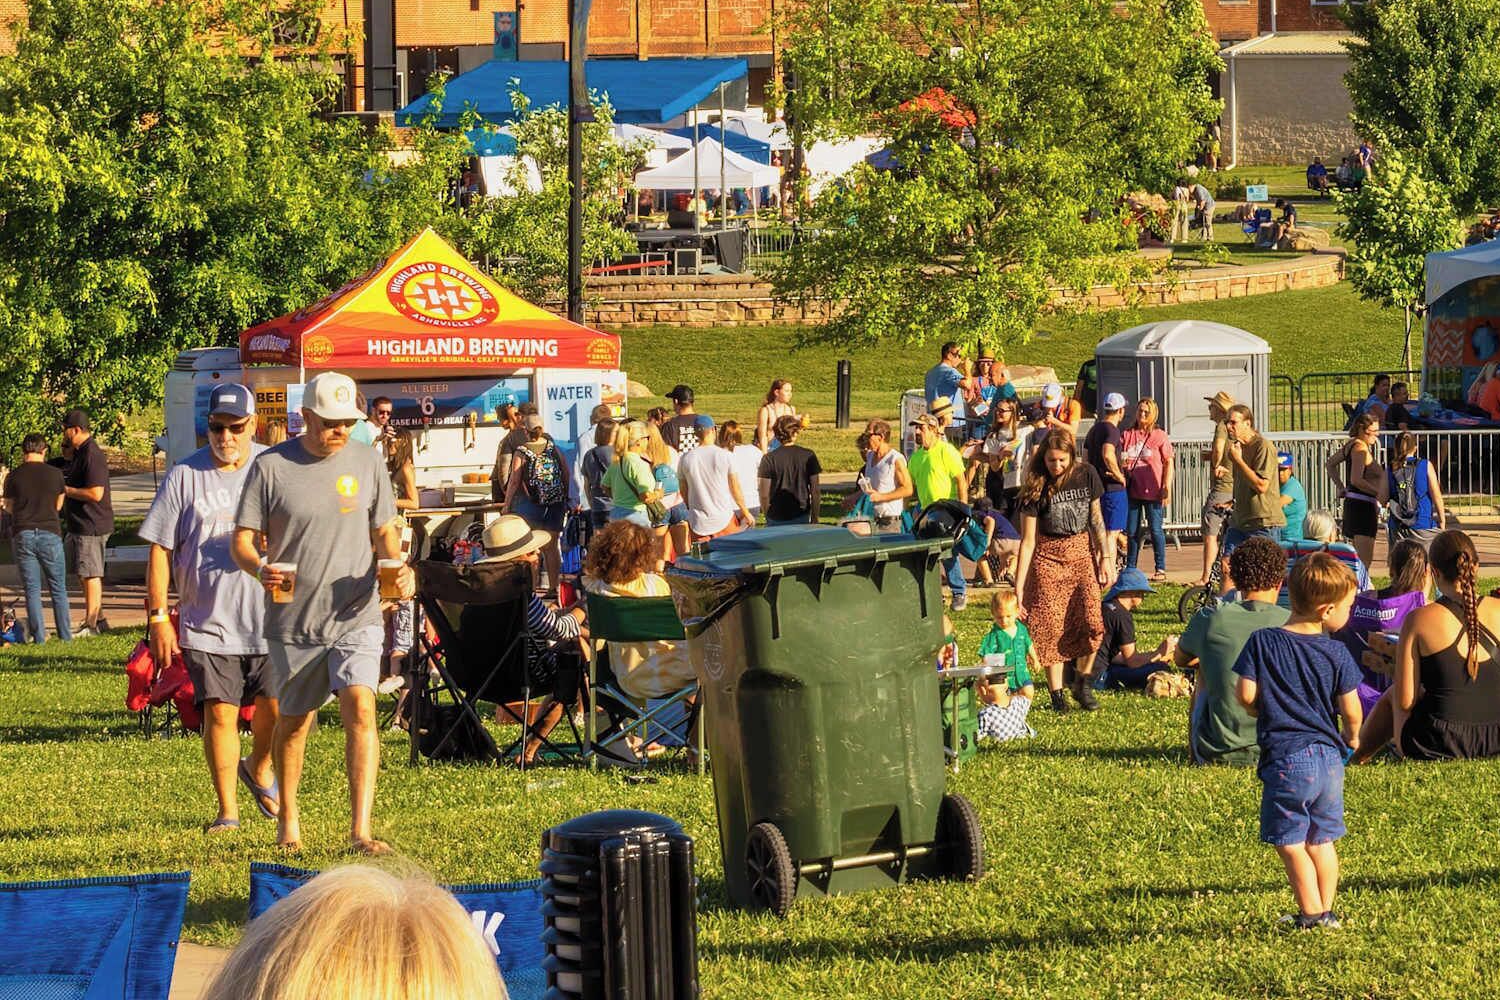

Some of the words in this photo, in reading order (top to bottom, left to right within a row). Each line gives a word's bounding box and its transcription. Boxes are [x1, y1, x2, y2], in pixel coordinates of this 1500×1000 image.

[390, 263, 437, 294] HIGHLAND
[441, 265, 494, 300] BREWING
[368, 338, 465, 356] HIGHLAND
[469, 339, 558, 357] BREWING
[422, 383, 449, 393] BEER
[546, 385, 593, 401] WATER
[554, 402, 578, 442] $1
[1354, 604, 1398, 620] Academy
